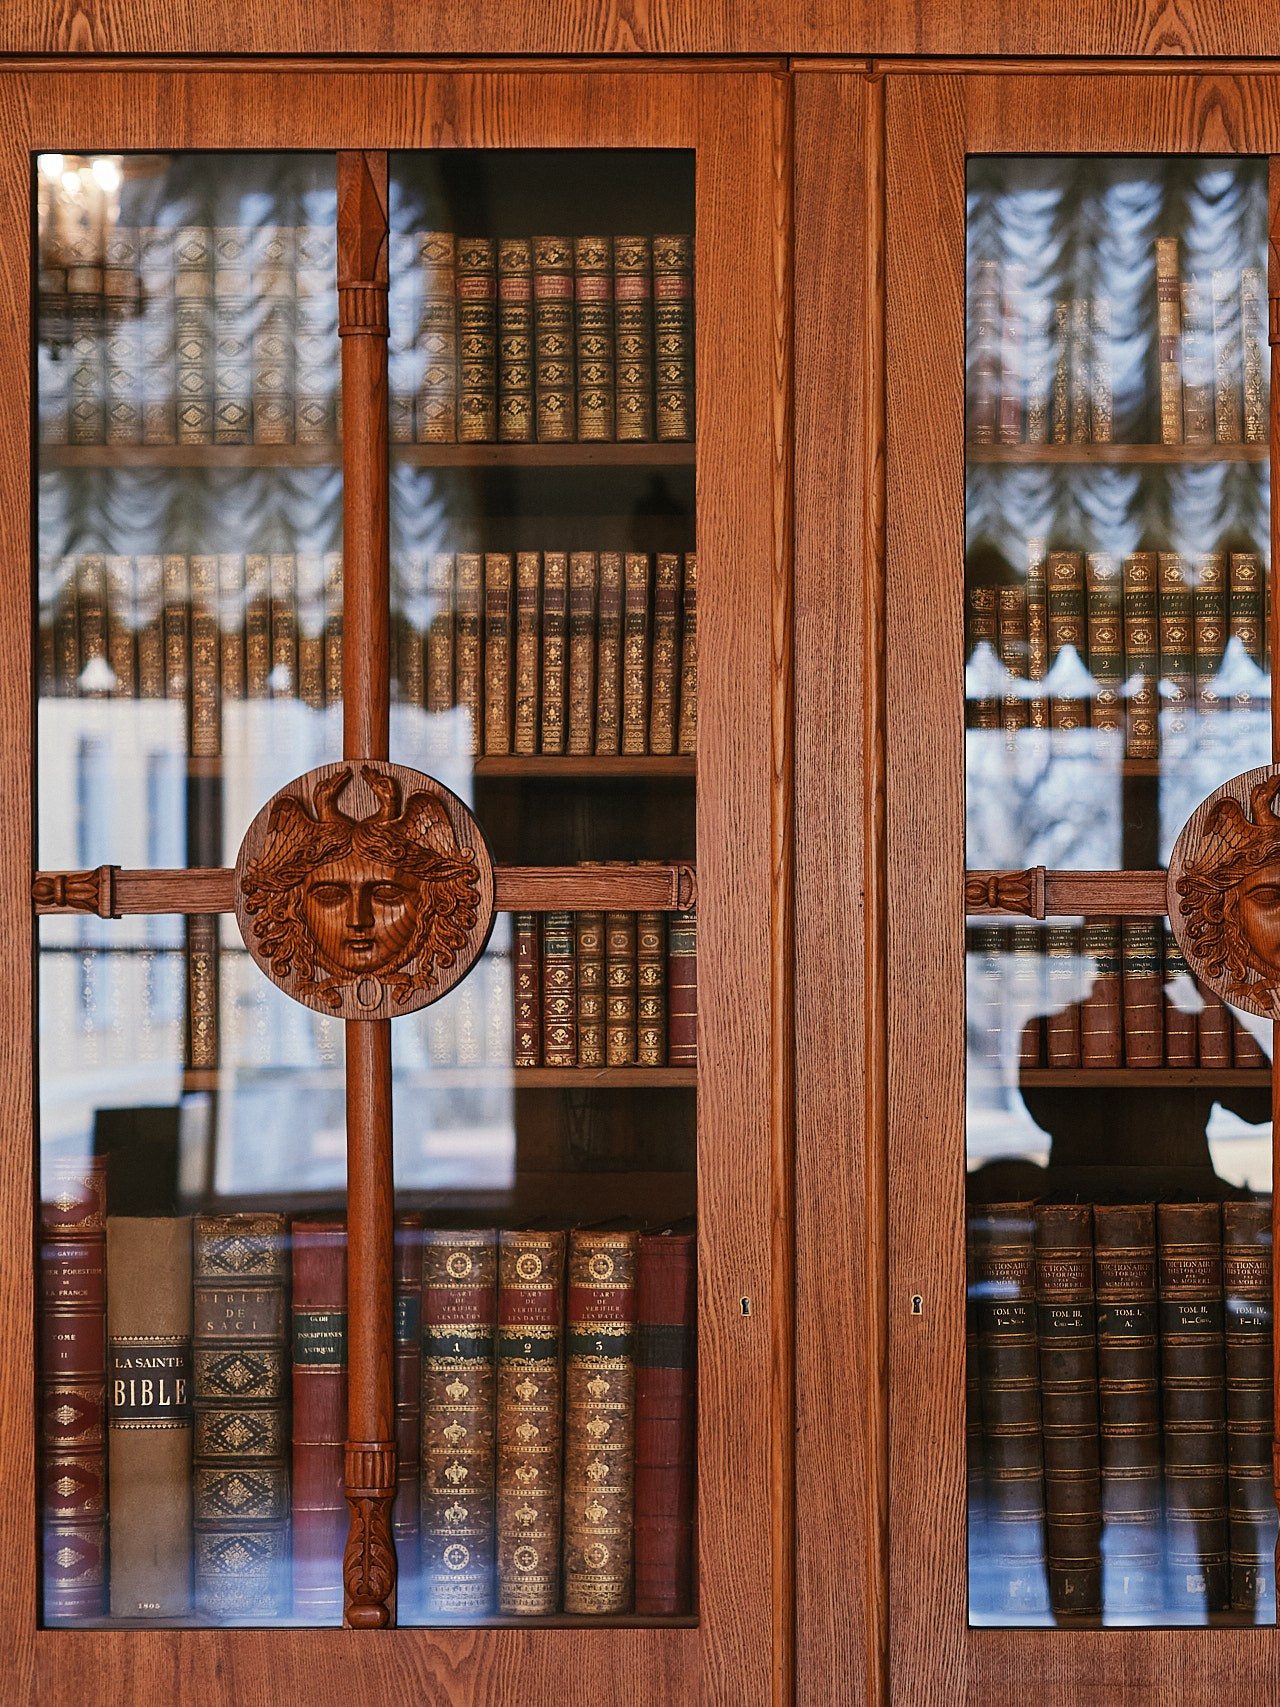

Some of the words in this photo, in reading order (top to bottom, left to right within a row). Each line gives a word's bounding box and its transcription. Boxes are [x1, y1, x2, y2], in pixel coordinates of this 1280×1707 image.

[1102, 660, 1110, 669] 2
[519, 944, 527, 956] 1
[1100, 1263, 1151, 1271] DICTIONAIRE
[201, 1293, 265, 1304] BIBLE
[225, 1308, 246, 1319] DE
[207, 1320, 257, 1331] SACI
[297, 1331, 343, 1340] INSCRIPTIONES
[452, 1342, 461, 1353] 1
[524, 1343, 532, 1353] 2
[115, 1358, 133, 1369] LA
[135, 1356, 184, 1368] SAINTE
[114, 1378, 187, 1407] BIBLE
[137, 1602, 161, 1610] 1805
